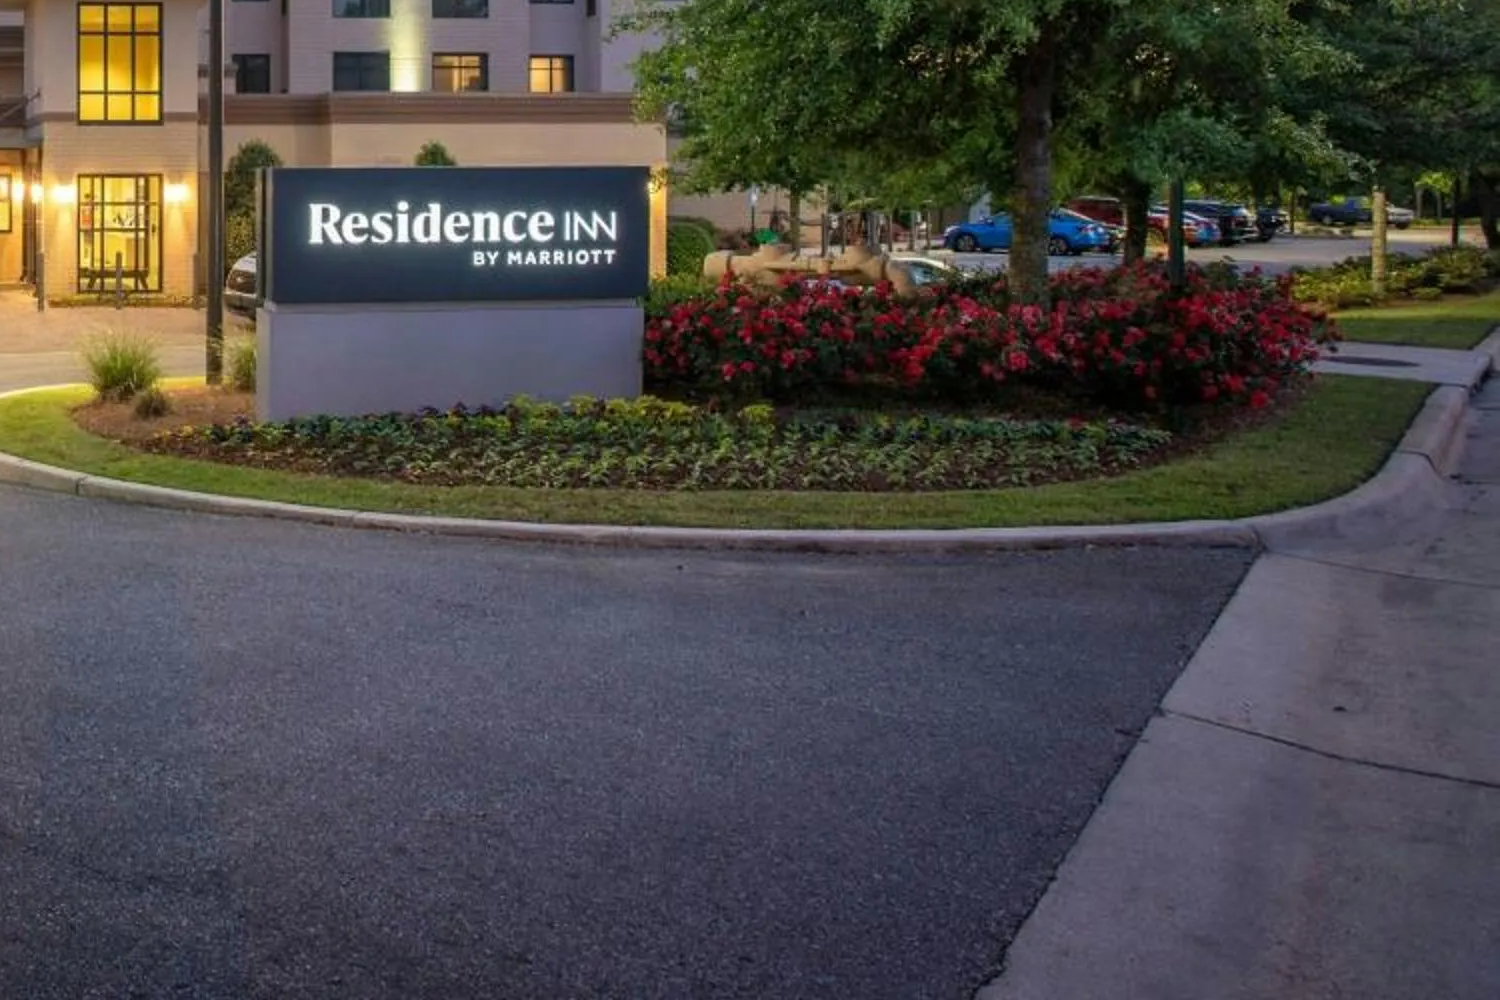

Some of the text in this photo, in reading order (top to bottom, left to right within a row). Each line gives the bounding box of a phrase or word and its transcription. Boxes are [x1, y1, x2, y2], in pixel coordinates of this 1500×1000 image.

[308, 200, 617, 245] Residence INN
[472, 249, 617, 267] BY MARRIOTT
